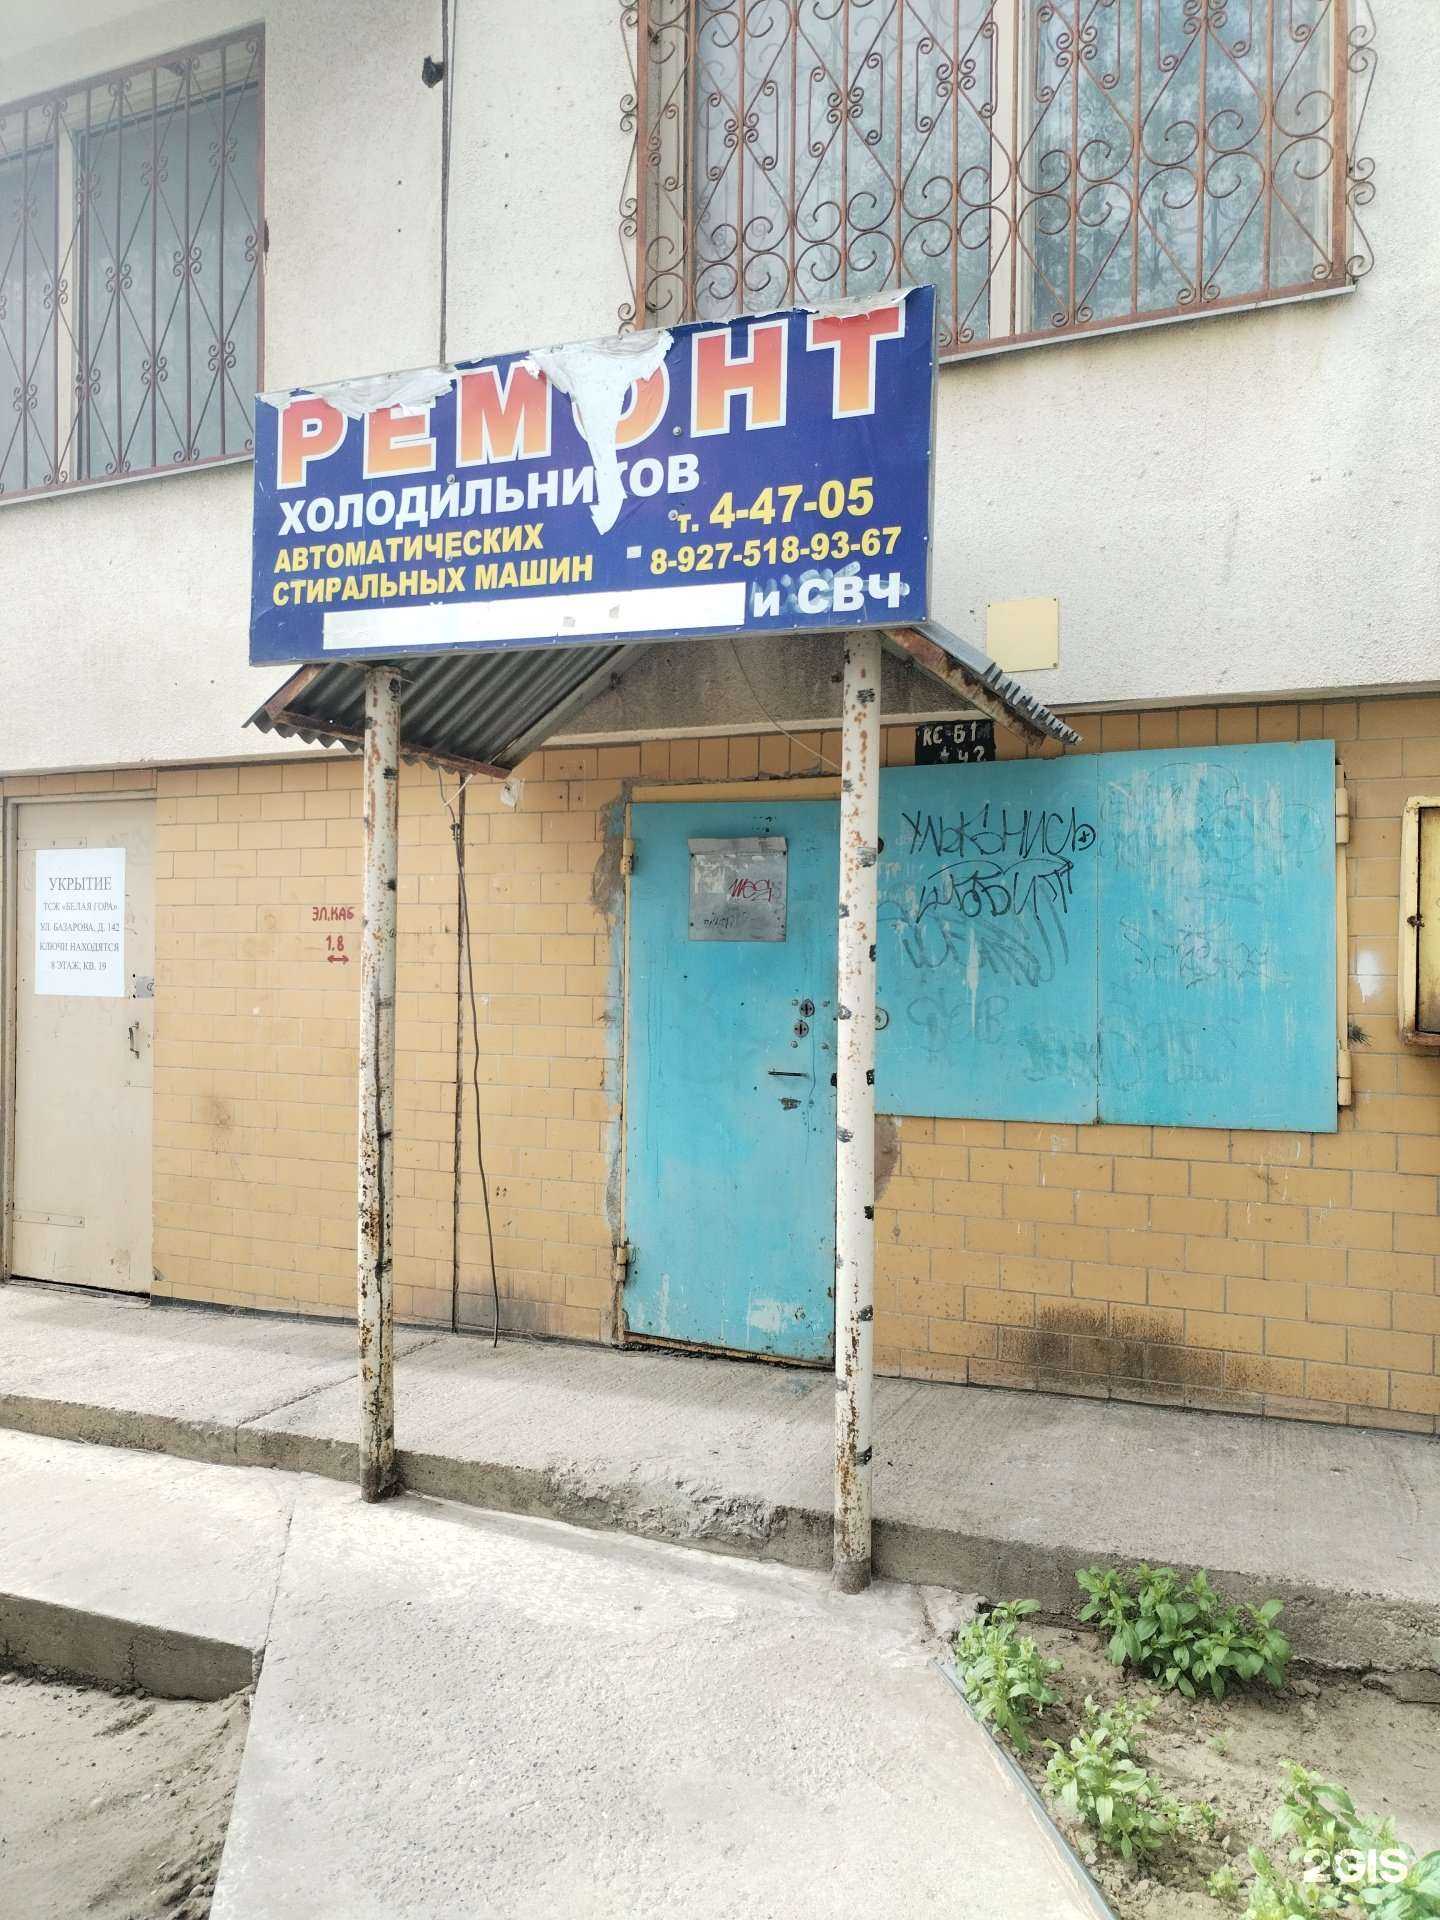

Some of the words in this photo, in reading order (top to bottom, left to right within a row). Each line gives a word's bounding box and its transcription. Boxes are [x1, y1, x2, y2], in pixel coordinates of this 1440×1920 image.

[709, 476, 874, 529] 4-47-05
[273, 523, 544, 573] АВТОМАТИЧЕСКИХ
[650, 526, 902, 575] 8-927-518-93-67
[273, 567, 466, 607] СТИРАЛЬНЫХ
[475, 554, 594, 590] МАШИН
[797, 571, 901, 615] СВЧ
[43, 902, 60, 911] ТСЖ
[61, 902, 92, 911] «БЕЛАЯ
[93, 902, 118, 911] ГОРА»
[49, 876, 112, 891] УКРЫТИЕ
[39, 942, 68, 952] КЛЮЧИ
[70, 942, 120, 952] НАХОДЯТСЯ
